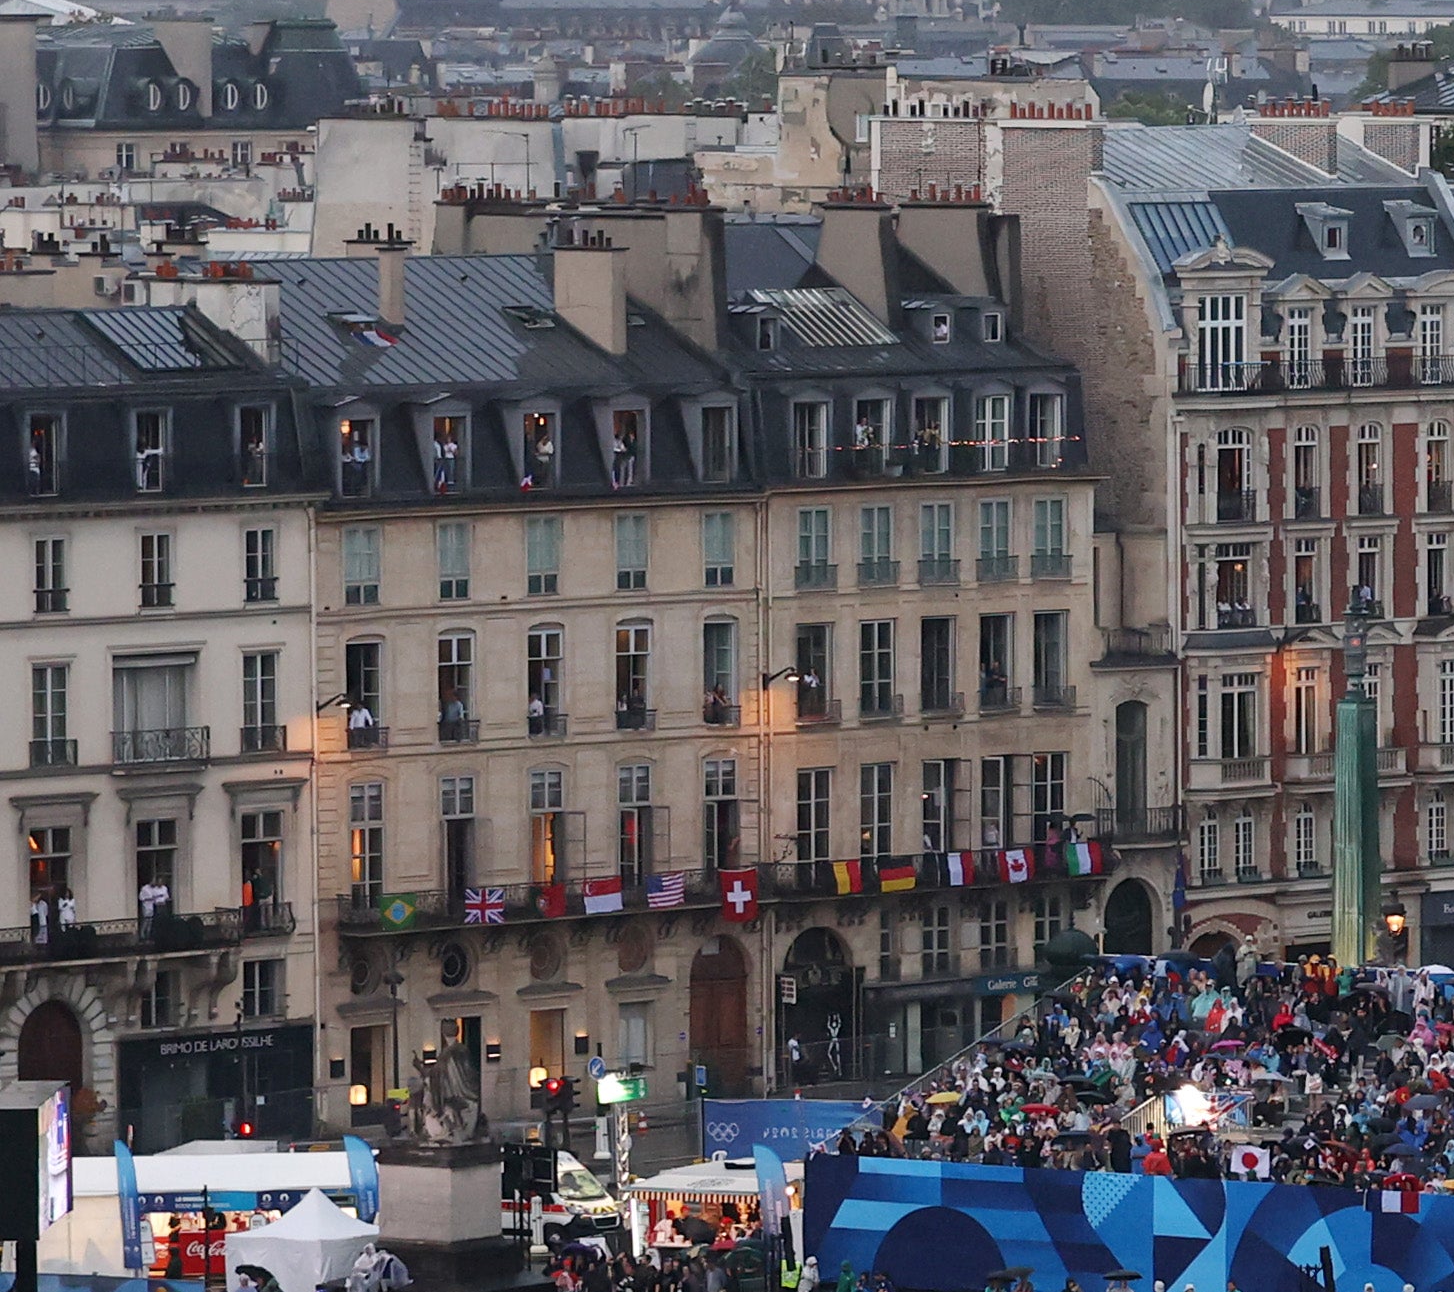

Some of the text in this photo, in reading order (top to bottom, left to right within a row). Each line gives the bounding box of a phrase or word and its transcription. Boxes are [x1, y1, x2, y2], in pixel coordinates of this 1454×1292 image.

[160, 1034, 274, 1055] BRIMO DE LAROSSILHE
